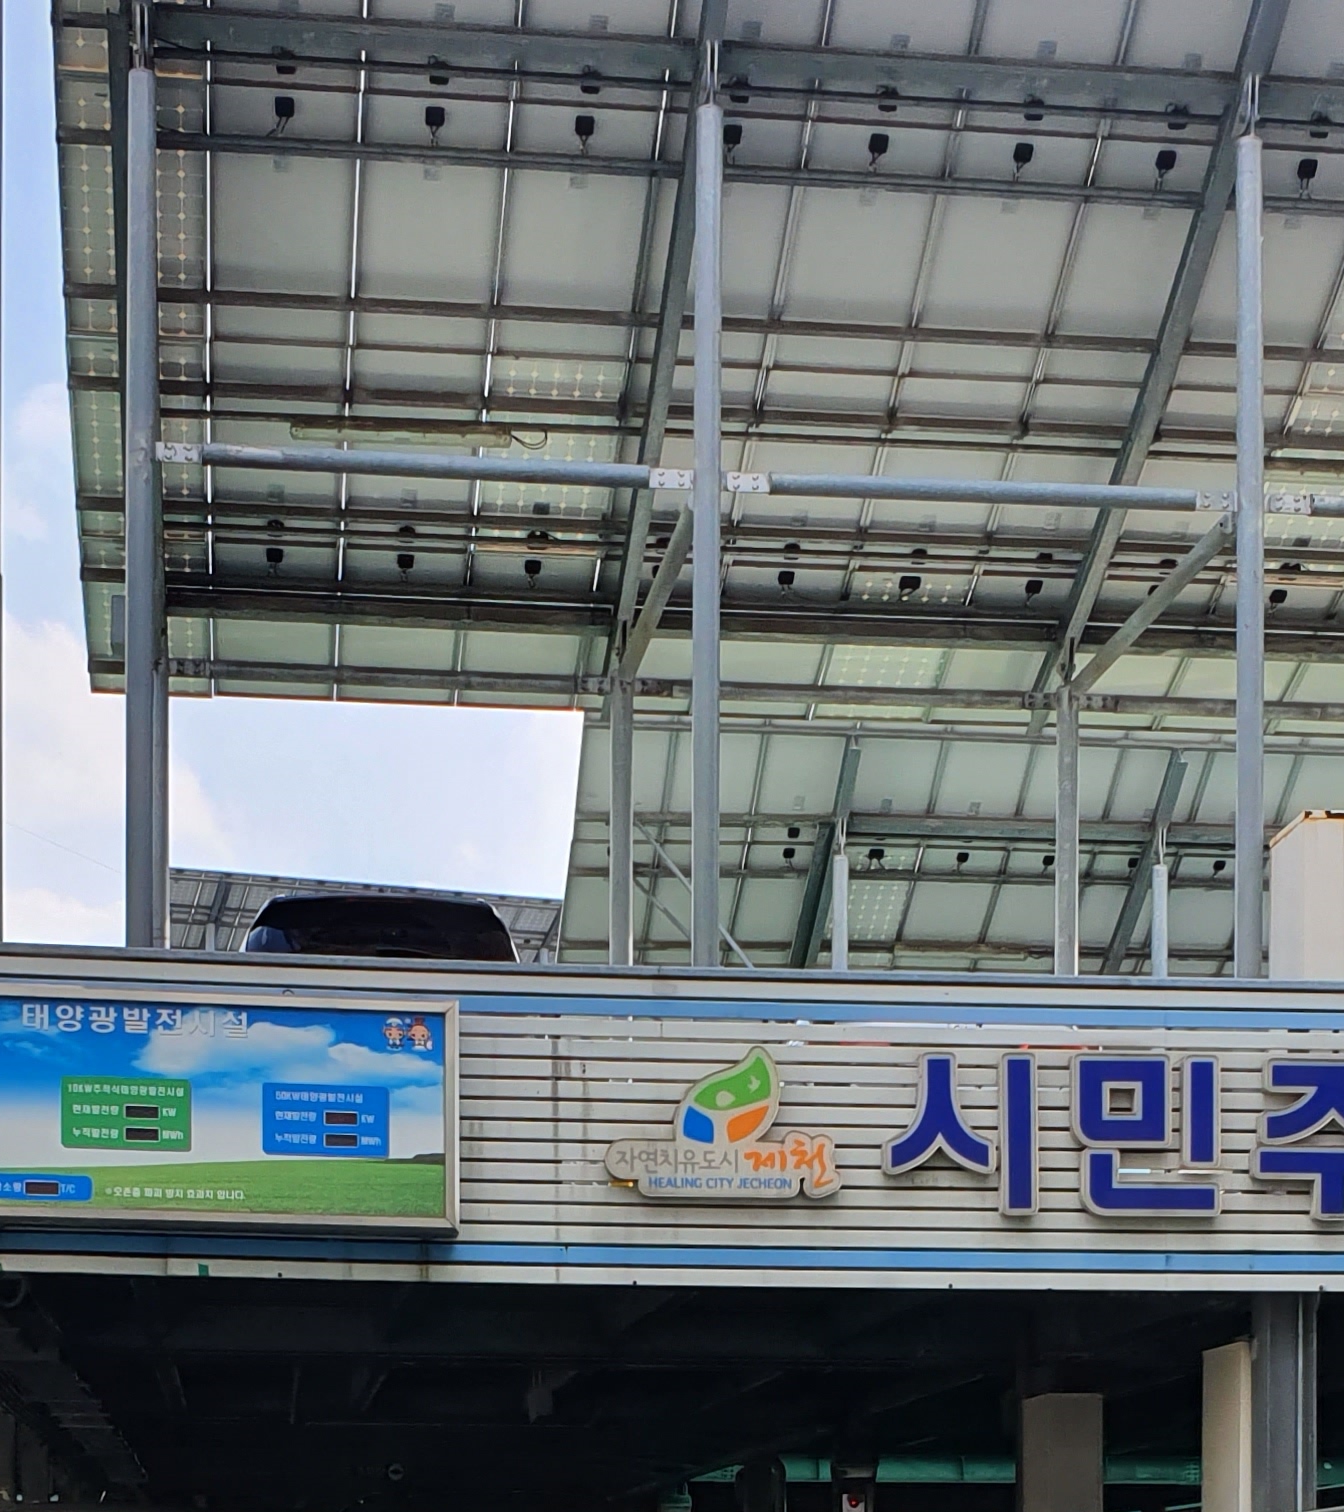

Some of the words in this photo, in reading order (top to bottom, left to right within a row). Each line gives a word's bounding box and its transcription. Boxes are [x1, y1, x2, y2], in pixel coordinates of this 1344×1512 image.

[21, 1004, 250, 1038] 태양광발전시설
[614, 1147, 740, 1175] 자연치유도시
[743, 1138, 834, 1189] 제천
[648, 1175, 703, 1190] HEALING
[706, 1176, 734, 1190] CITY
[736, 1176, 793, 1190] JECHEON
